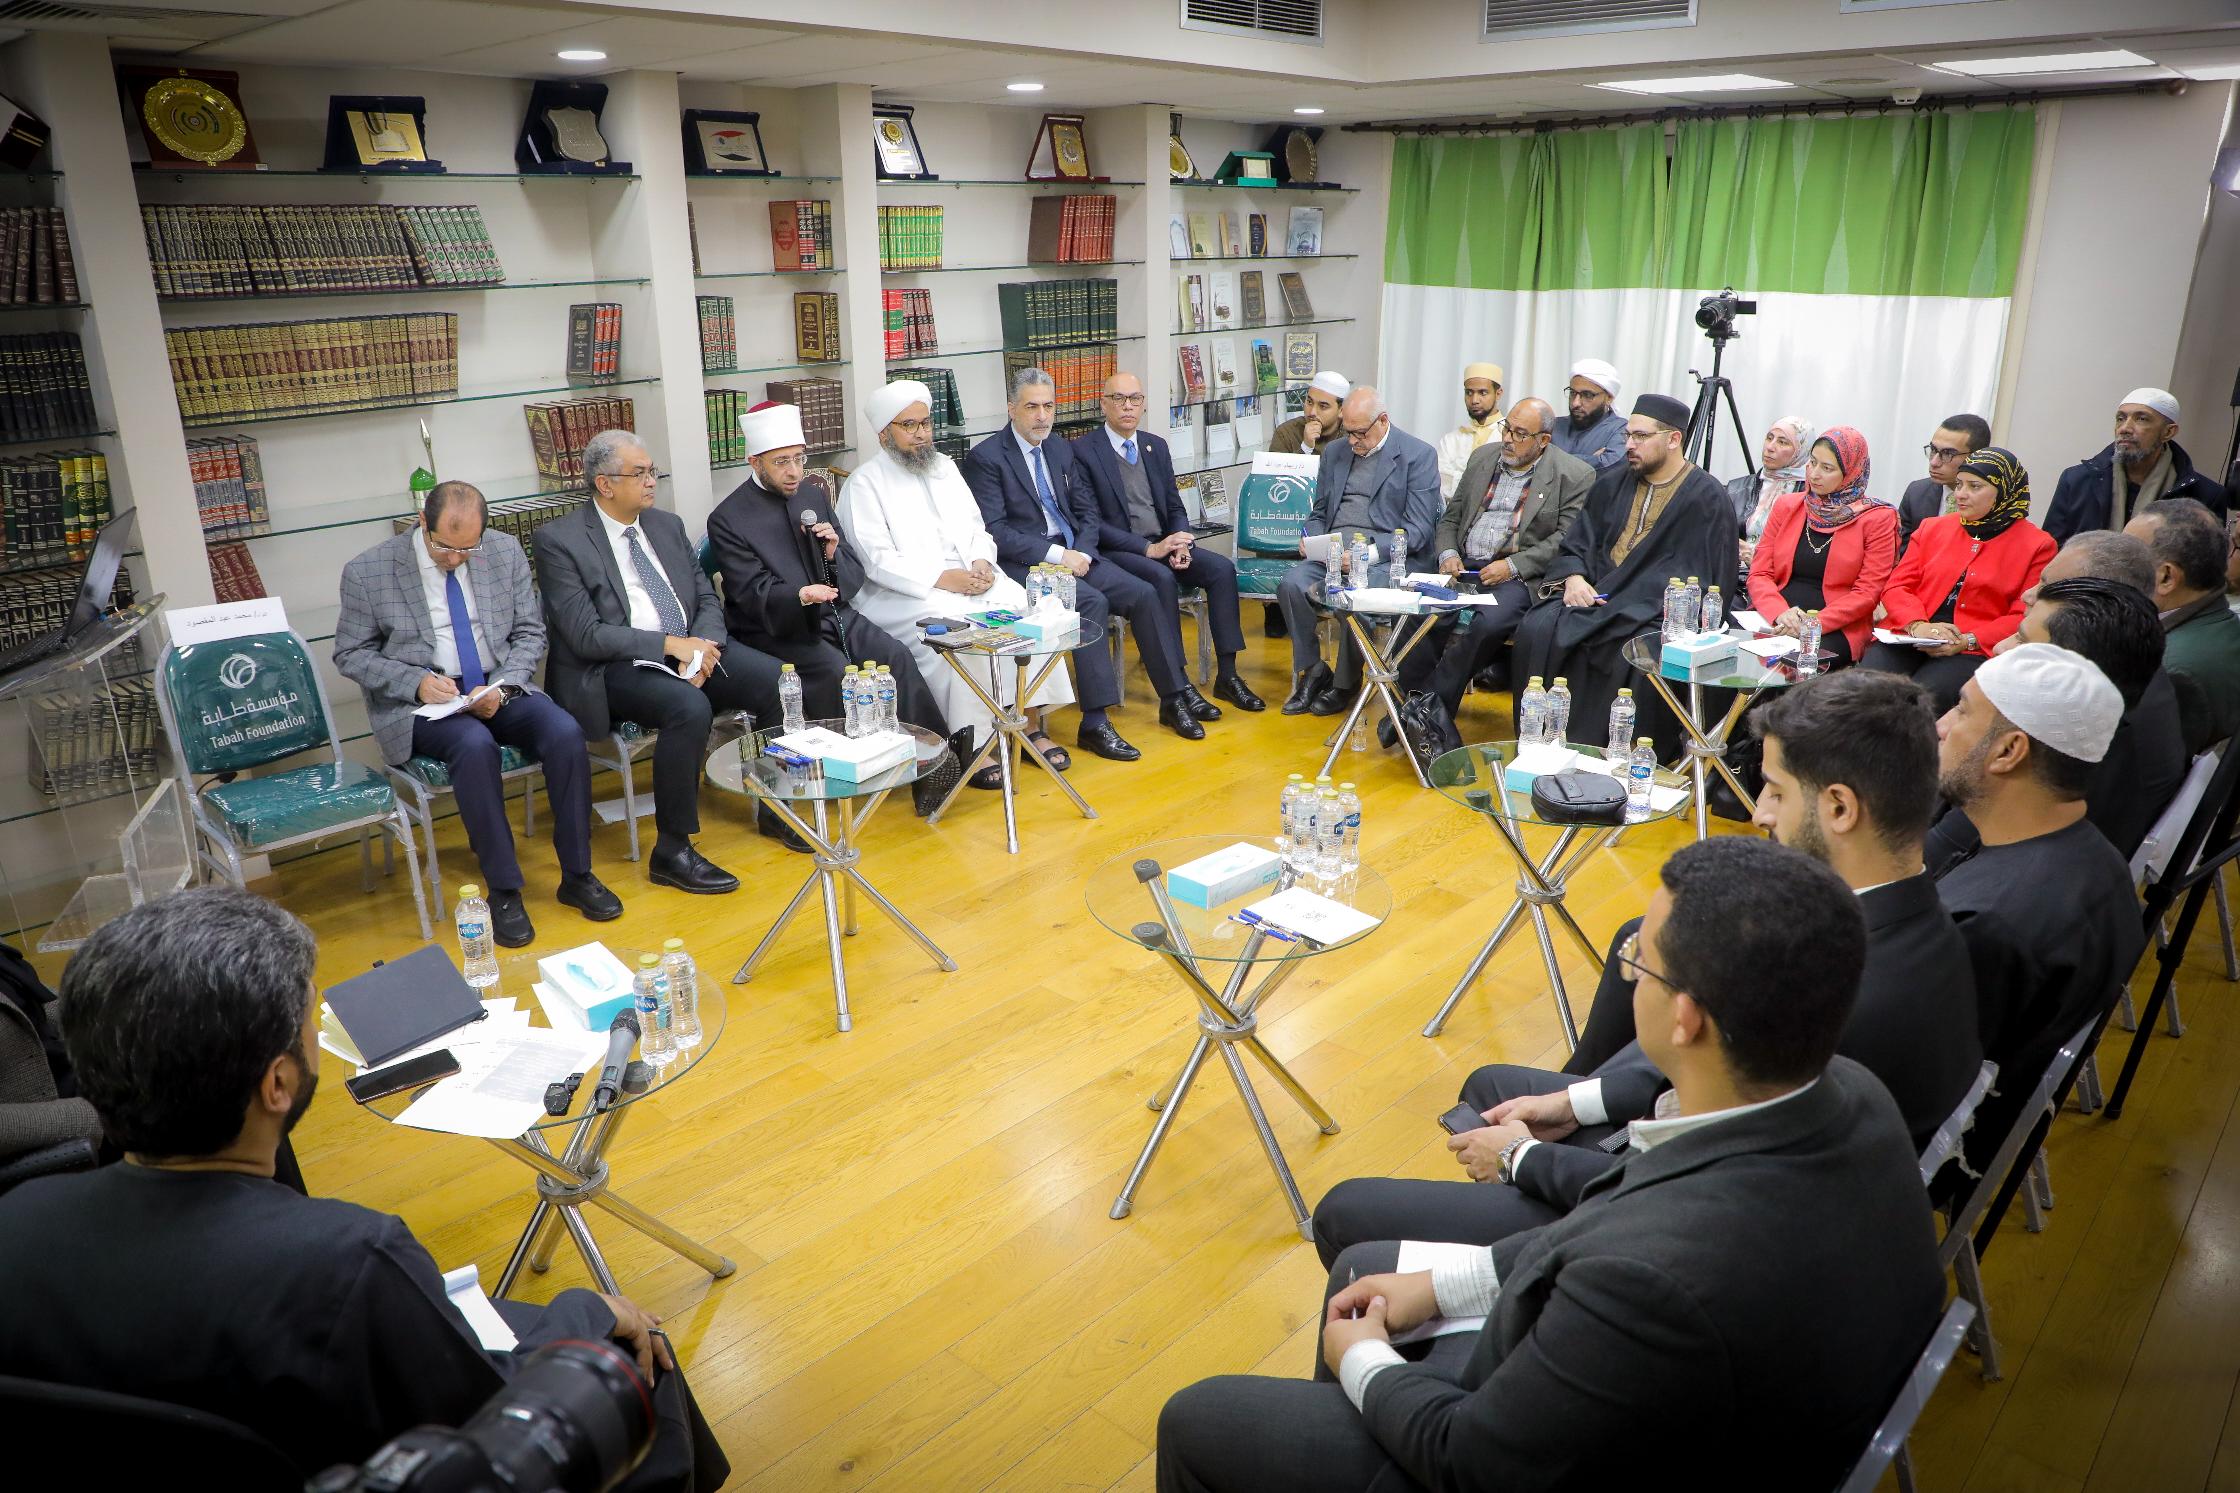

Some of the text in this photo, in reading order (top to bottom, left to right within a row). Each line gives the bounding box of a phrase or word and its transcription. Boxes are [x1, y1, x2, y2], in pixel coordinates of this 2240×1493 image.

[1250, 526, 1302, 536] Tabah Foundatio
[201, 689, 298, 727] مؤسسة طابة
[210, 715, 306, 749] Tabah Foundation
